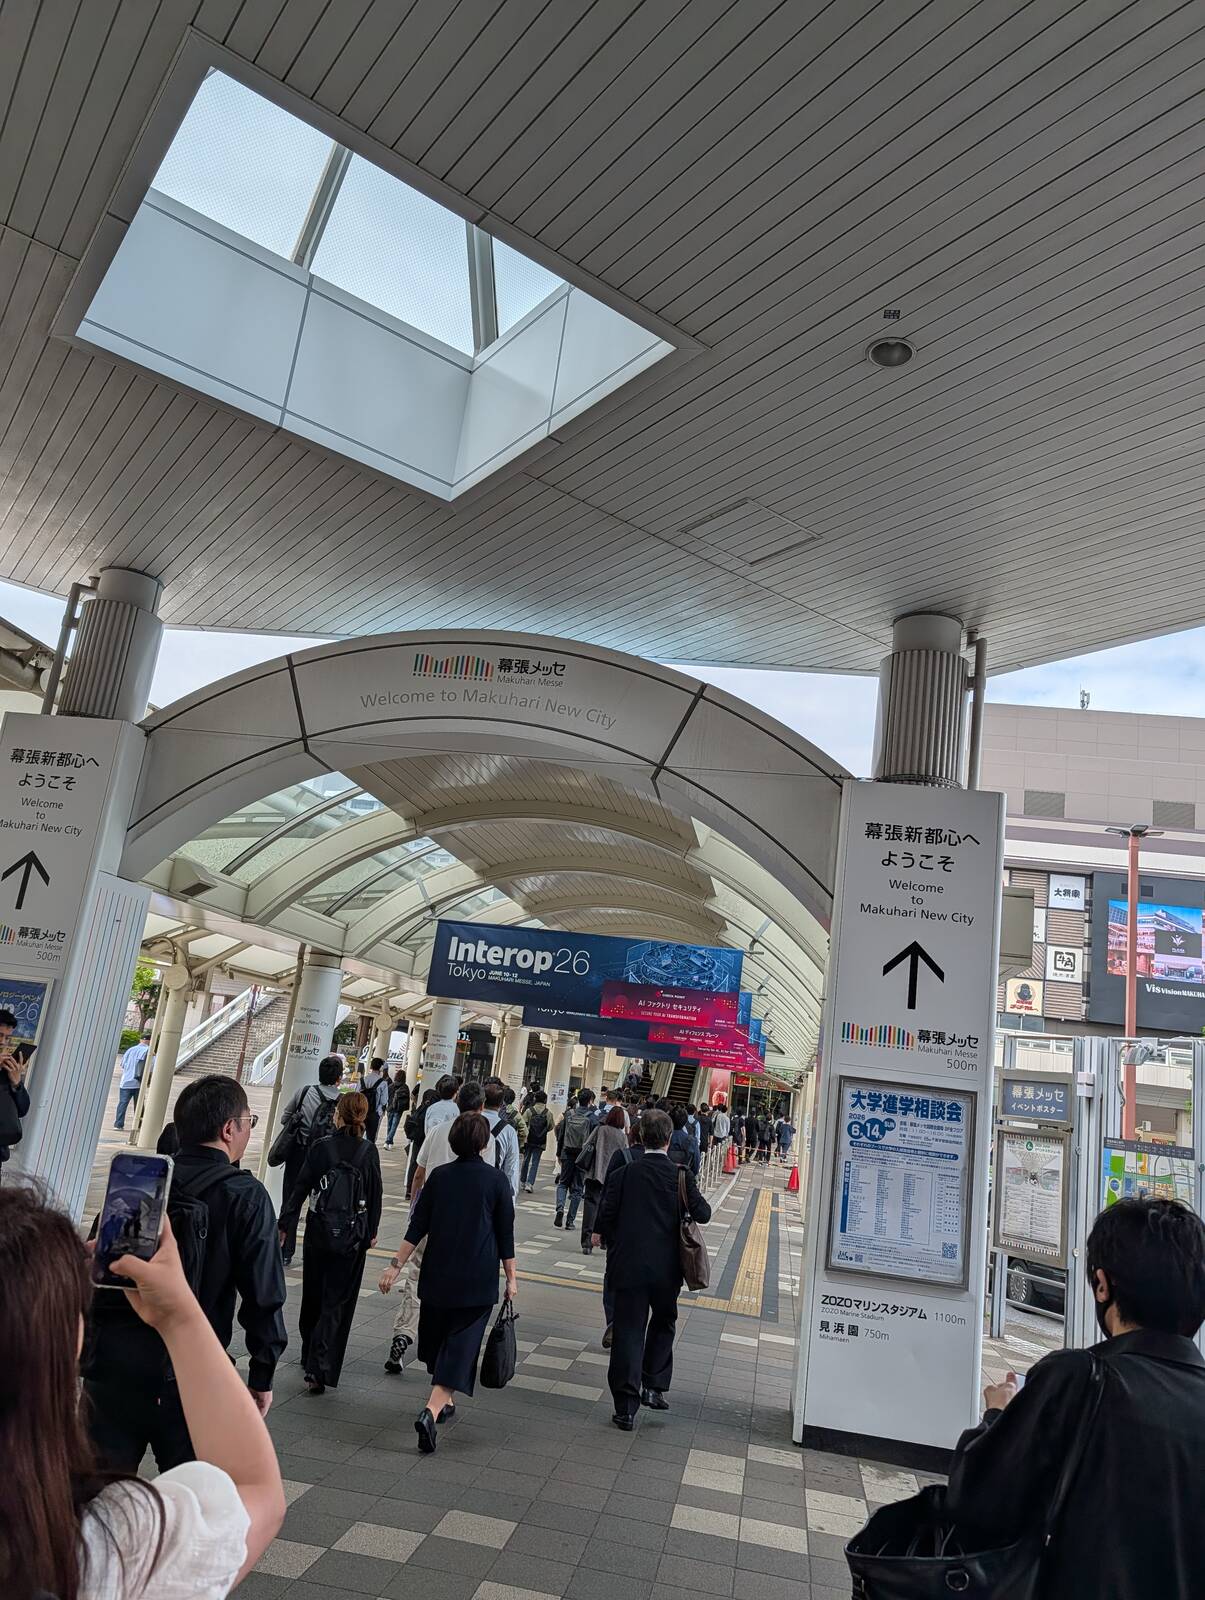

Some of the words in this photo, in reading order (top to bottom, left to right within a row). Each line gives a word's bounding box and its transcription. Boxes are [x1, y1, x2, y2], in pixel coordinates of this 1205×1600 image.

[497, 658, 567, 677] 幕張メッセ
[497, 675, 536, 686] Makuhari
[538, 677, 564, 688] Messe
[360, 690, 435, 709] Welcome
[440, 689, 458, 702] to
[462, 689, 541, 709] Makuhari
[544, 699, 582, 718] New
[586, 708, 617, 731] City
[10, 748, 100, 769] 幕張新都心へ
[18, 772, 77, 791] ようこそ
[21, 797, 64, 810] Welcome
[36, 811, 46, 820] to
[41, 823, 63, 833] New
[64, 825, 83, 837] City
[864, 822, 980, 847] 幕張新都心へ
[881, 850, 955, 873] ようこそ
[889, 879, 944, 894] Welcome
[911, 895, 924, 905] to
[860, 903, 917, 918] Makuhari
[920, 909, 948, 921] New
[951, 912, 975, 926] City
[18, 926, 66, 943] 幕張メッセ
[16, 940, 43, 949] Makuhari
[45, 943, 63, 951] Messe
[36, 951, 61, 961] 500m
[447, 936, 553, 974] Interop
[554, 948, 590, 976] 26
[447, 962, 486, 982] Tokyo
[1145, 983, 1161, 994] Vis
[15, 1001, 39, 1020] 26
[917, 1029, 979, 1049] 幕張メッセ
[917, 1045, 953, 1056] Makuhari
[955, 1049, 978, 1059] Messe
[946, 1058, 978, 1072] 500m
[1011, 1084, 1064, 1103] 幕張メッセ
[850, 1091, 962, 1123] 大学進学相談会
[1011, 1103, 1064, 1113] イベントポスター
[821, 1294, 928, 1320] ZOZOマリンスタジアム
[934, 1312, 966, 1326] 1100m
[821, 1307, 839, 1315] ZOZO
[840, 1309, 860, 1318] Marine
[860, 1312, 885, 1321] Stadium
[819, 1320, 859, 1337] 見浜園
[864, 1328, 890, 1341] 750m
[819, 1334, 850, 1344] Mihamaen
